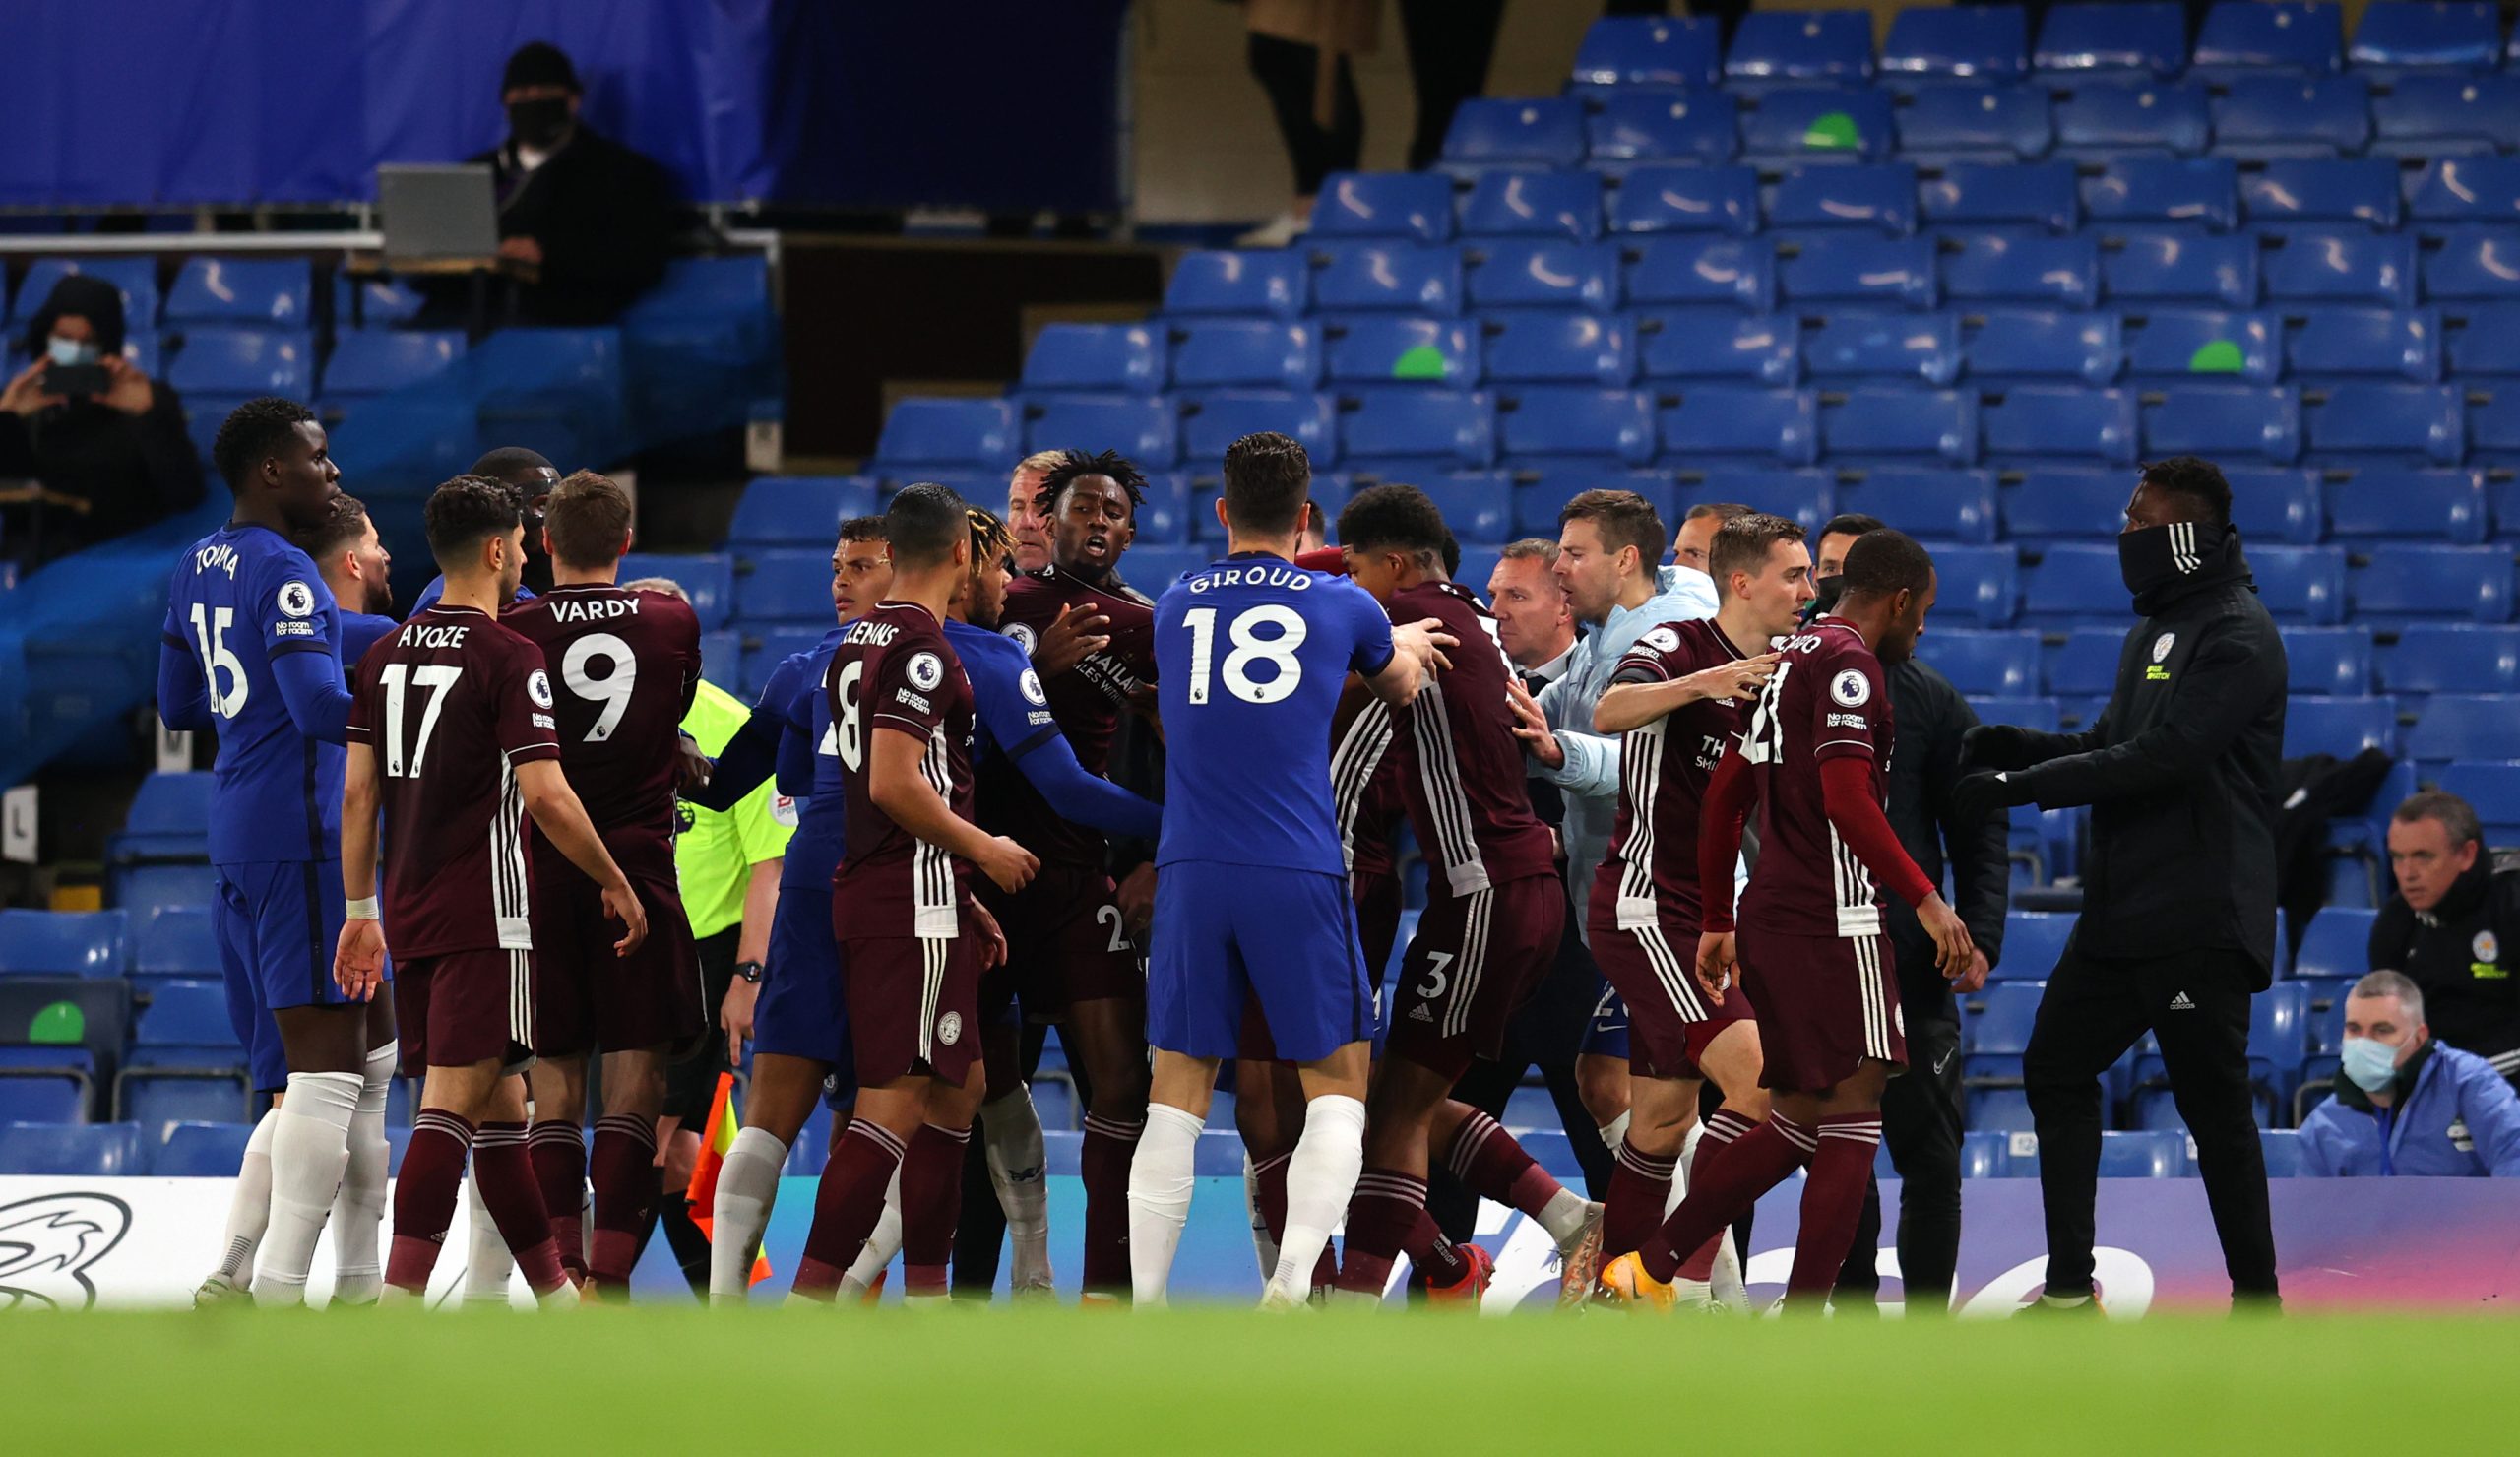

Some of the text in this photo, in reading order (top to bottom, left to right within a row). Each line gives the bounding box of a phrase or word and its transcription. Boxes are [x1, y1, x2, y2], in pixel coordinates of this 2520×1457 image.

[1189, 566, 1312, 593] GIROUD
[549, 598, 640, 623] VARDY
[398, 625, 470, 648] AYOZE
[1182, 604, 1307, 705] 18
[190, 602, 249, 720] 15
[562, 632, 637, 742] 9
[379, 664, 463, 778] 17
[838, 660, 864, 774] 8
[13, 805, 28, 839] L
[1097, 905, 1131, 952] 2
[1417, 950, 1454, 998] 3
[1408, 1010, 1434, 1023] adidas
